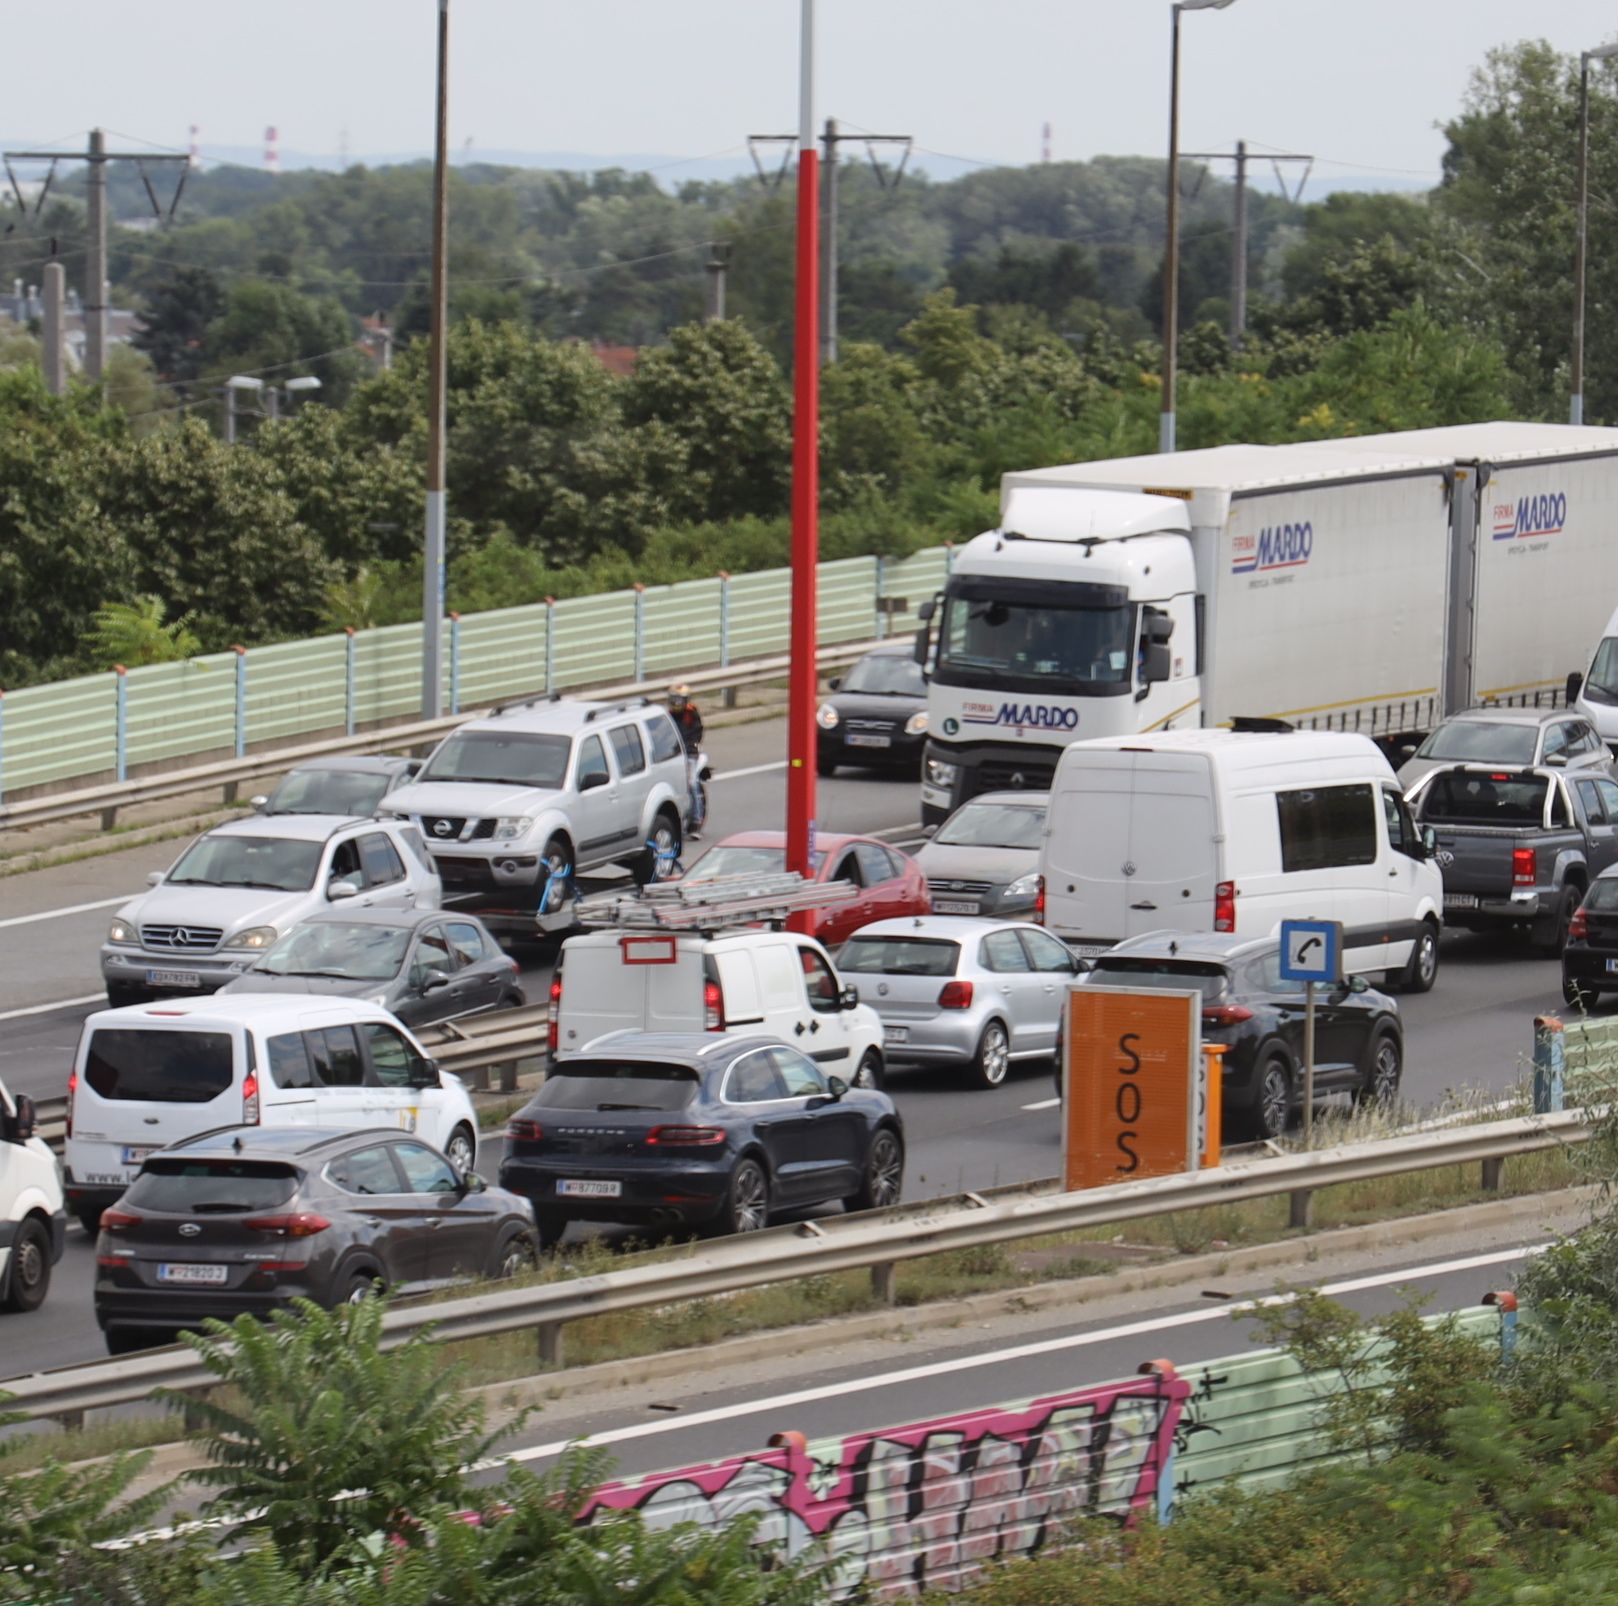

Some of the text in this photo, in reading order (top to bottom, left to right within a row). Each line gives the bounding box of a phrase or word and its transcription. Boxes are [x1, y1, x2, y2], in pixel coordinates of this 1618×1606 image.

[1515, 491, 1567, 533] MARDO
[1256, 520, 1313, 566] MARDO
[962, 702, 1078, 729] FIRMA MARDO
[1115, 1032, 1141, 1173] SOS
